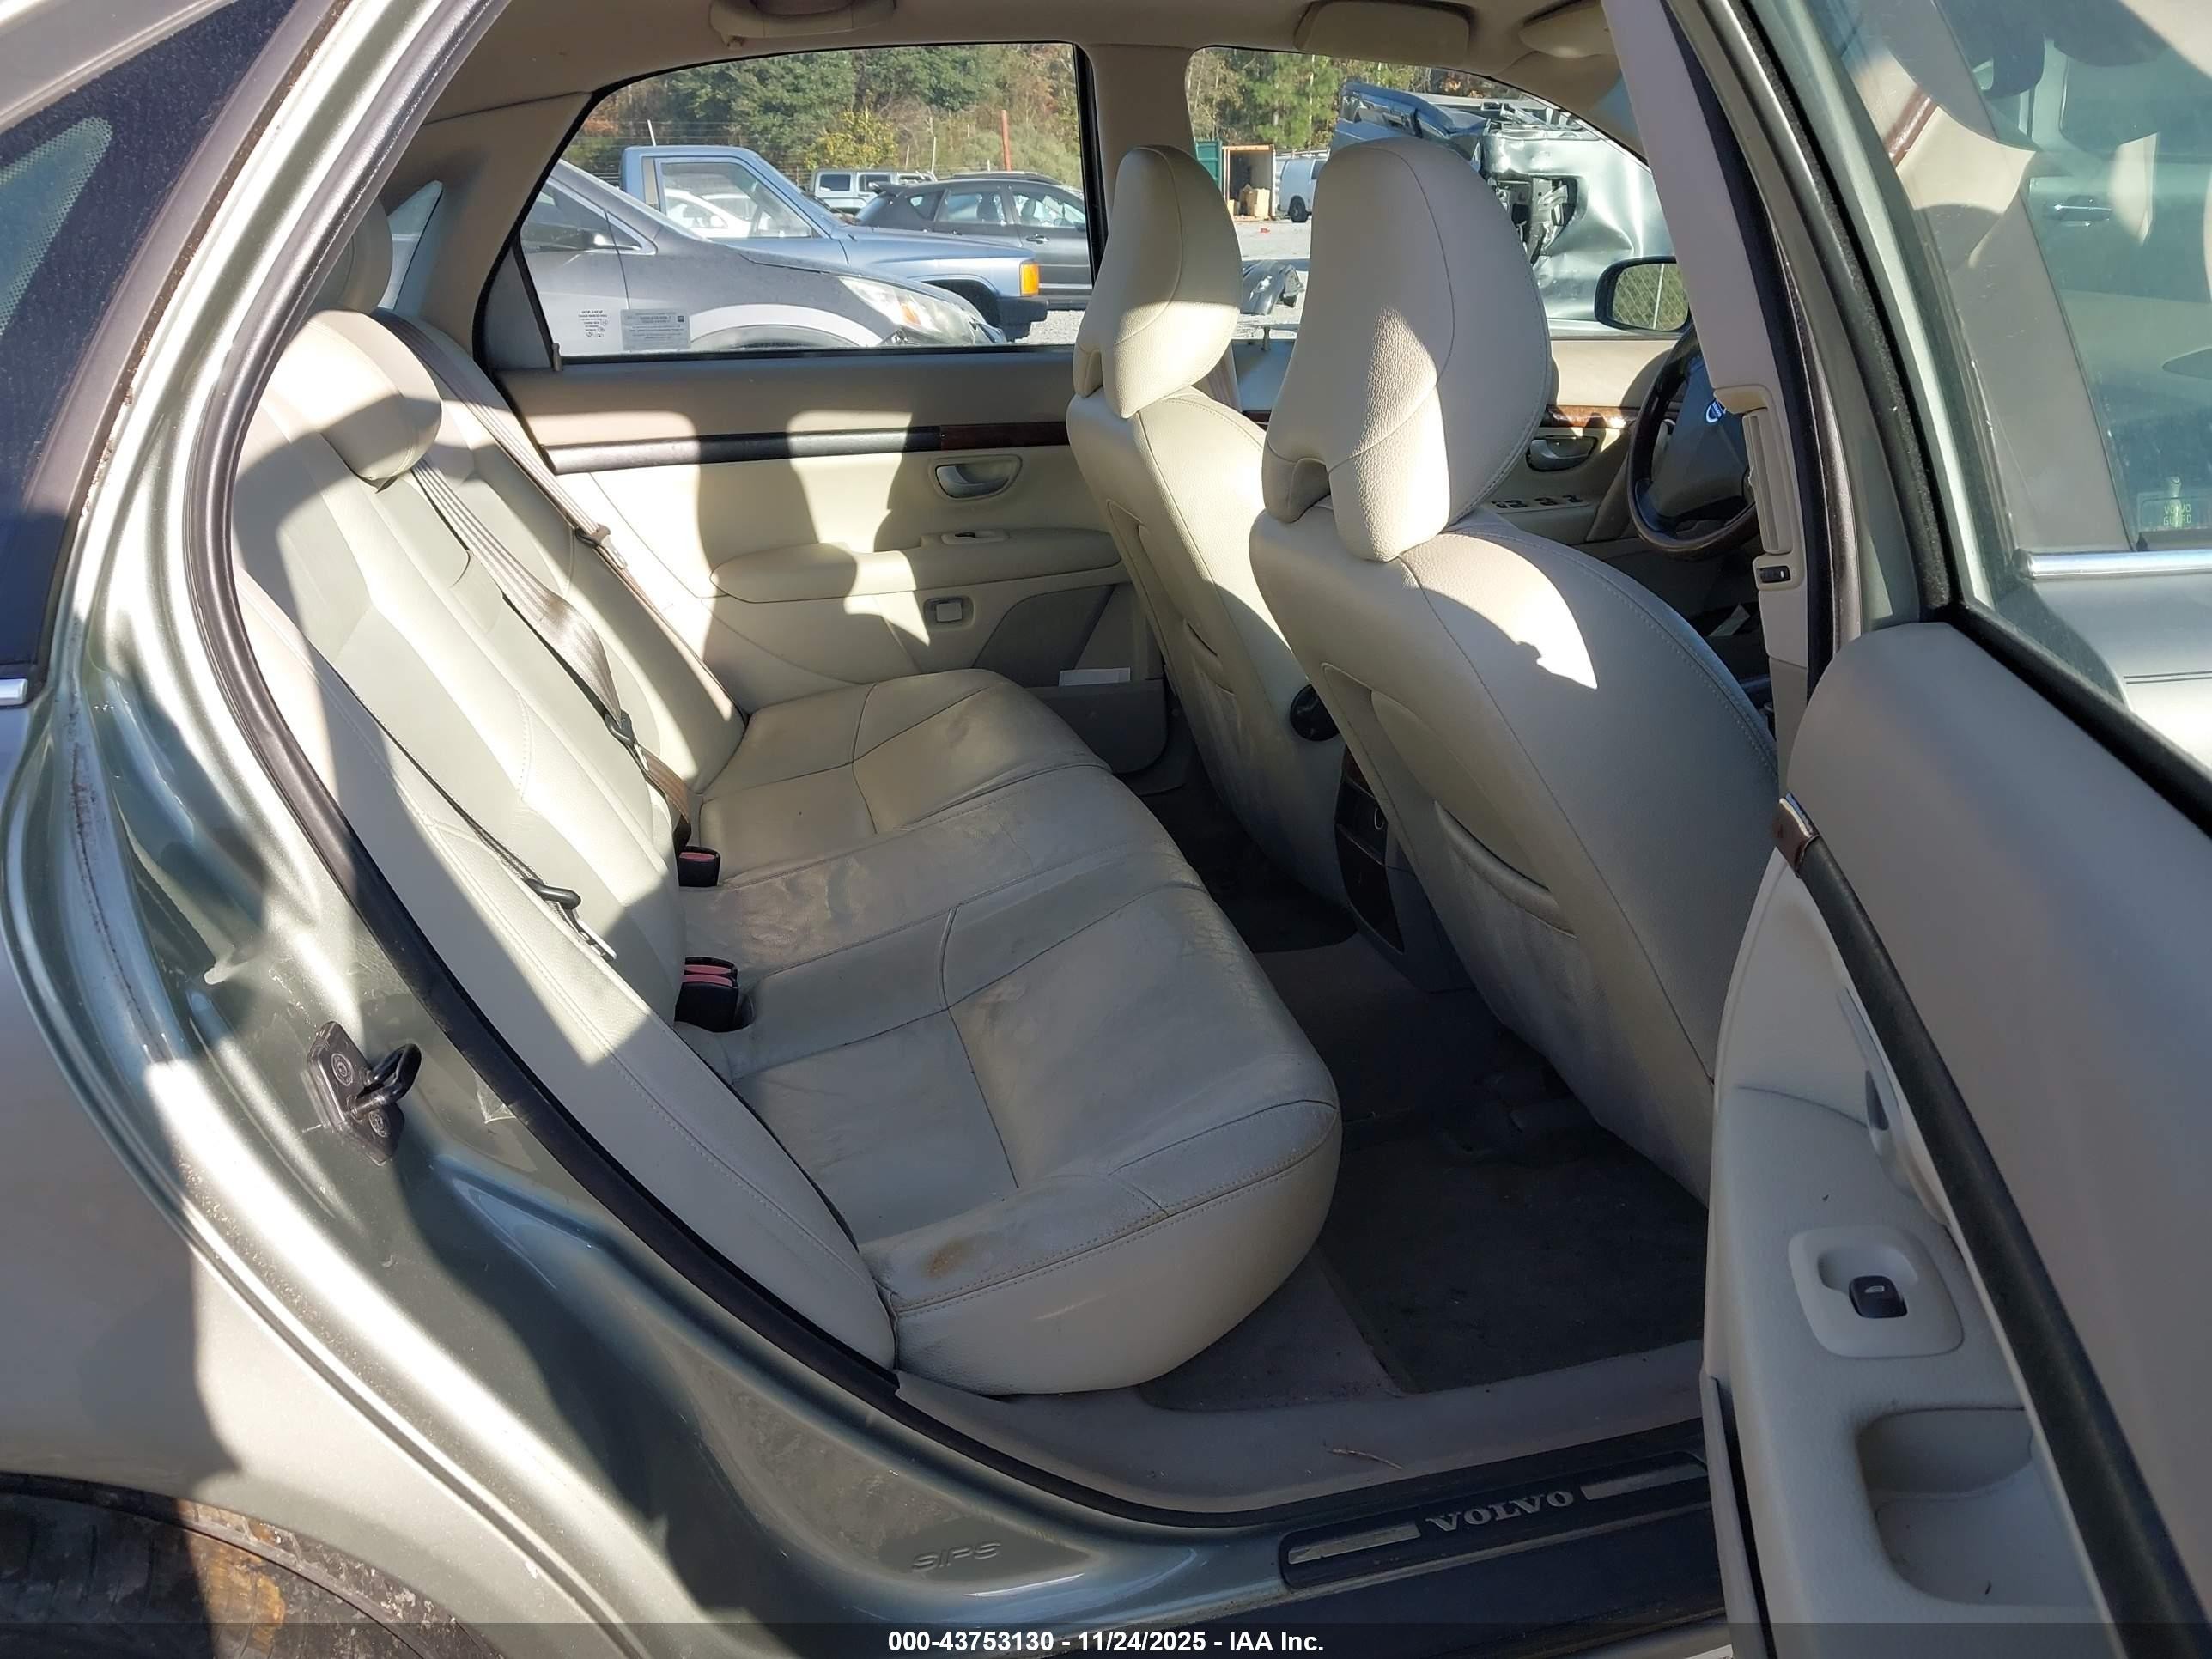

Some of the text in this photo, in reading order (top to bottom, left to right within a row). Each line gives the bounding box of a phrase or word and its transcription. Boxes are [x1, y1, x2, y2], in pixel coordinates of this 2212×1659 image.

[2163, 514, 2192, 526] GURD
[1425, 1491, 1574, 1532] VOLVO
[912, 1540, 1001, 1572] SIPS
